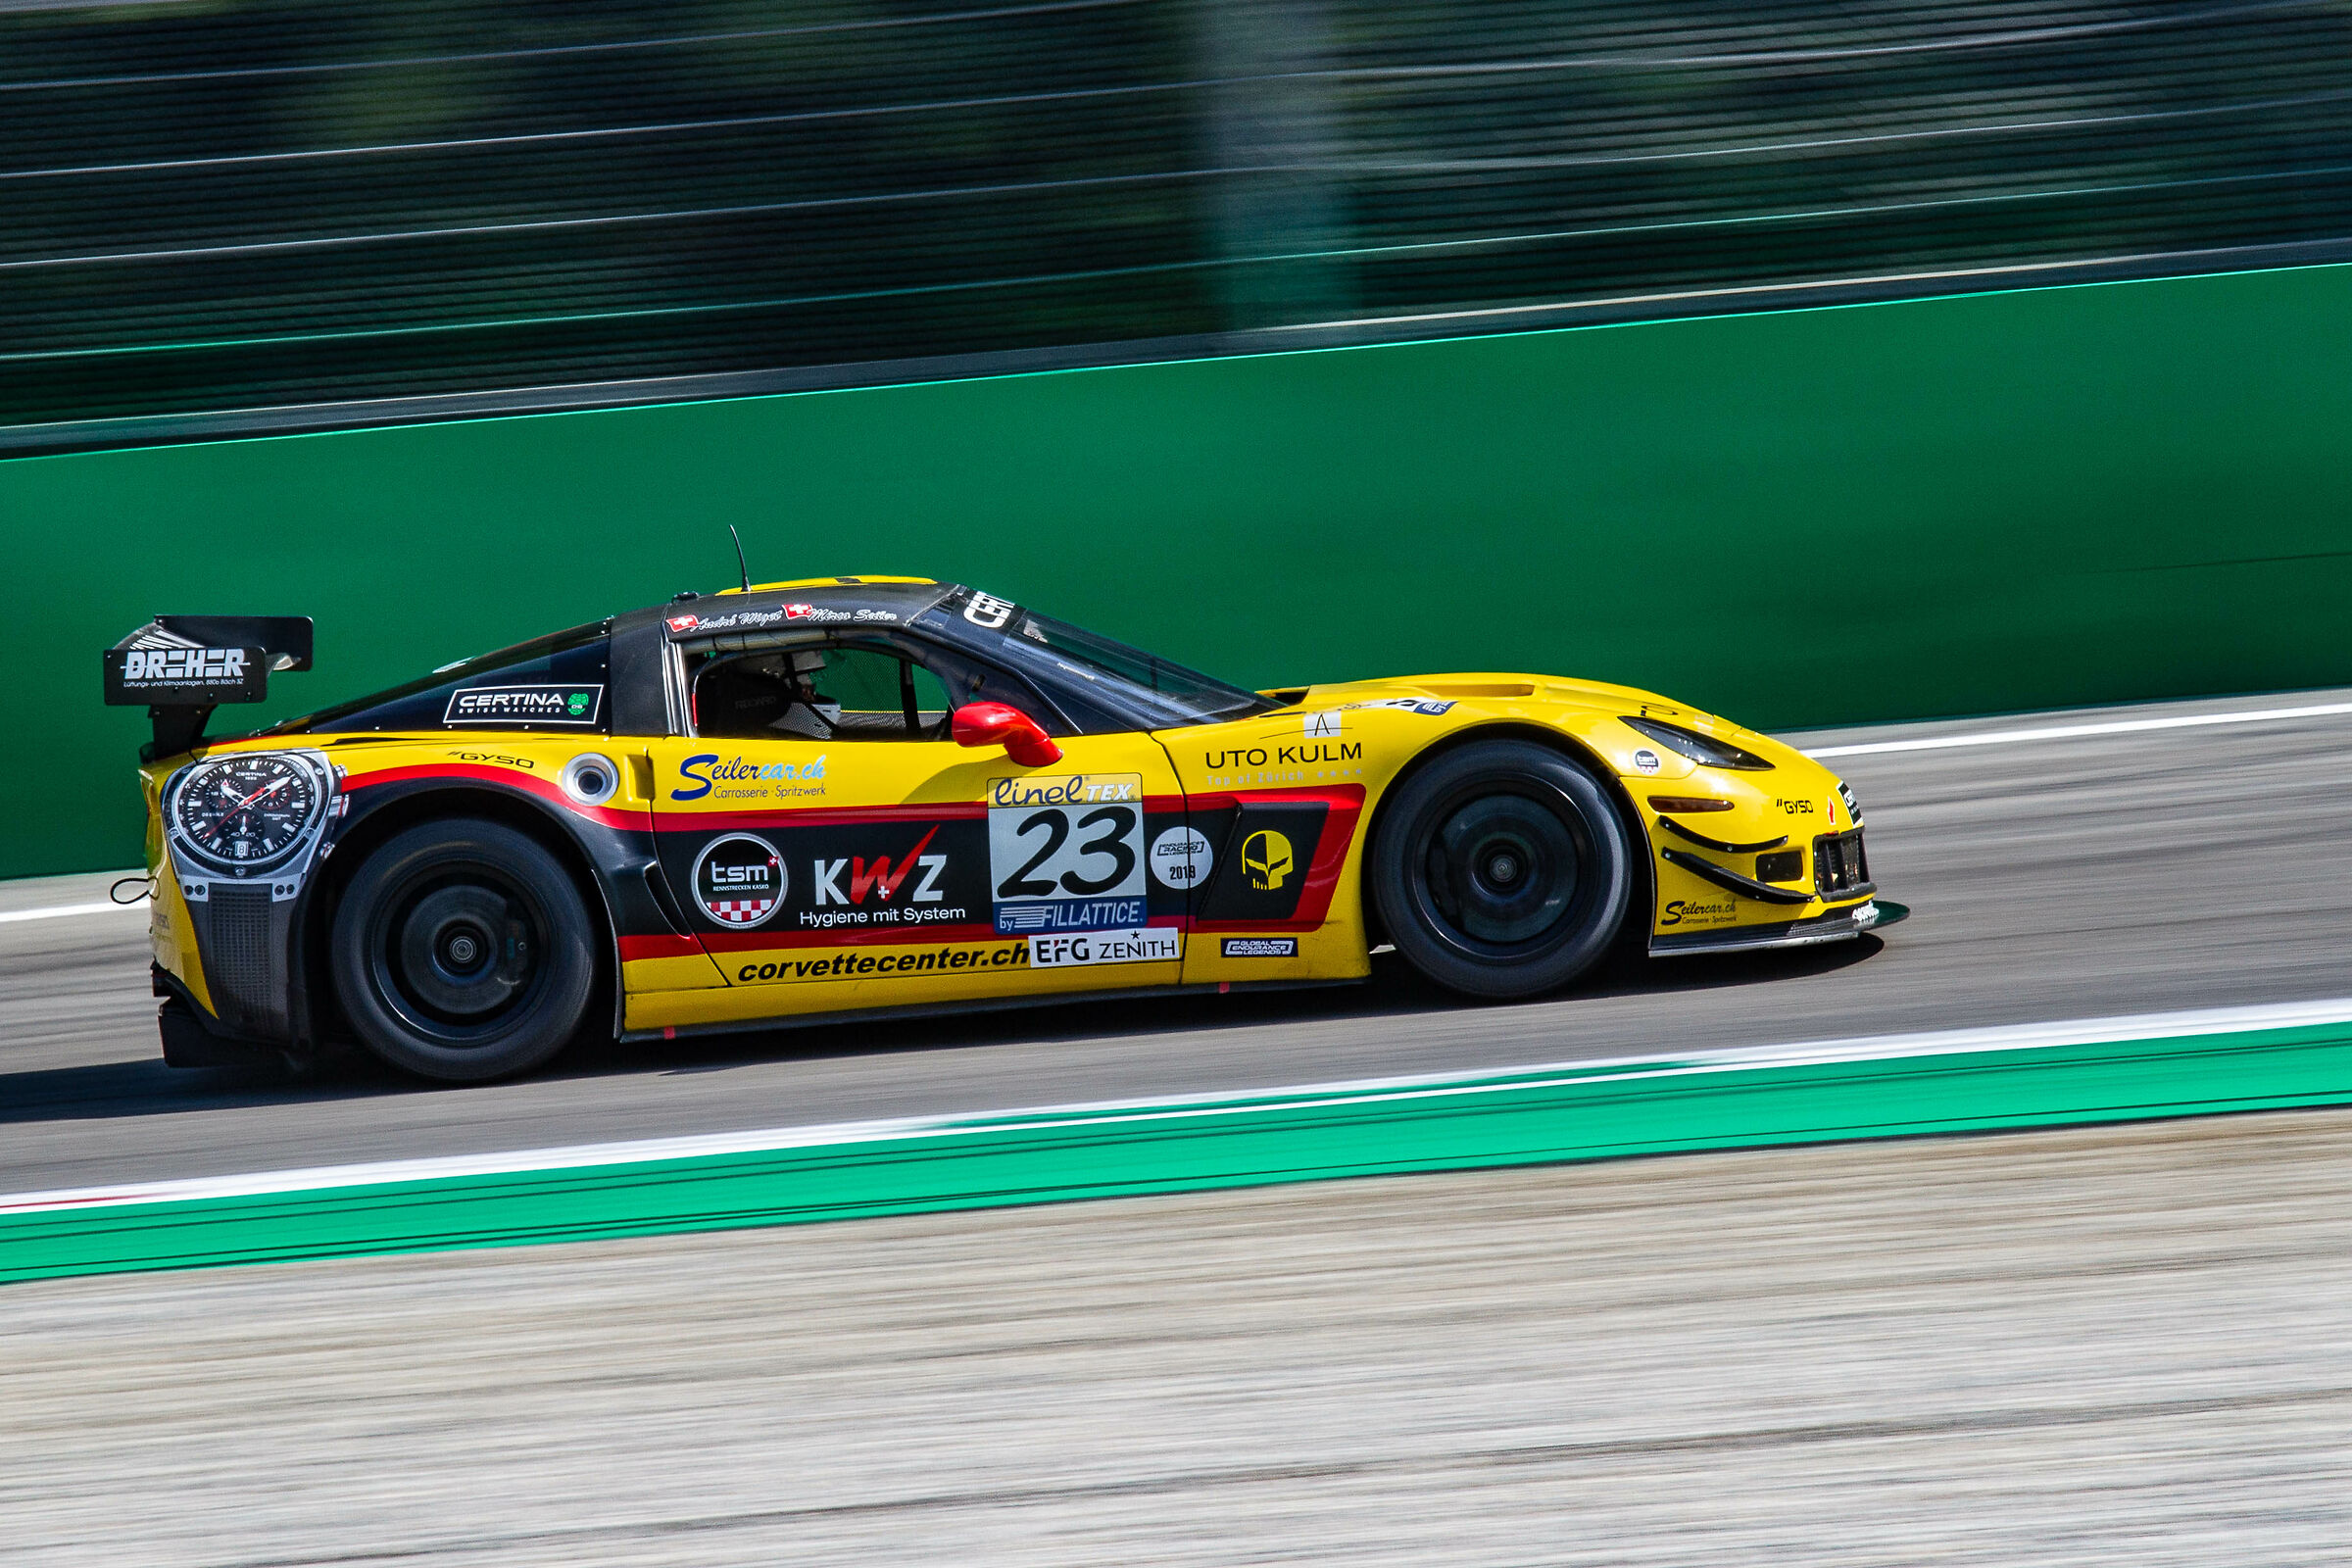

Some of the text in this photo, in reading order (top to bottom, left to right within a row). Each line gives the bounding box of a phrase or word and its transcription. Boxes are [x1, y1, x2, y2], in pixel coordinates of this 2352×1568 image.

[122, 648, 248, 679] DREHER
[460, 693, 564, 707] CERTINA
[1205, 743, 1362, 769] UTO KULM
[670, 754, 826, 801] Seilercar.ch
[995, 775, 1134, 807] linel TEX
[1206, 770, 1303, 786] Top of Zürich
[713, 783, 826, 800] Carrosserie Spritzwerk
[814, 824, 948, 906] KWZ
[997, 806, 1137, 899] 23
[710, 860, 768, 883] tsm
[800, 906, 966, 928] Hygiene mit System
[1000, 902, 1141, 931] by FILLATTICE
[738, 942, 1030, 982] corvettecenter.ch
[1036, 938, 1176, 963] EFG ZENITH
